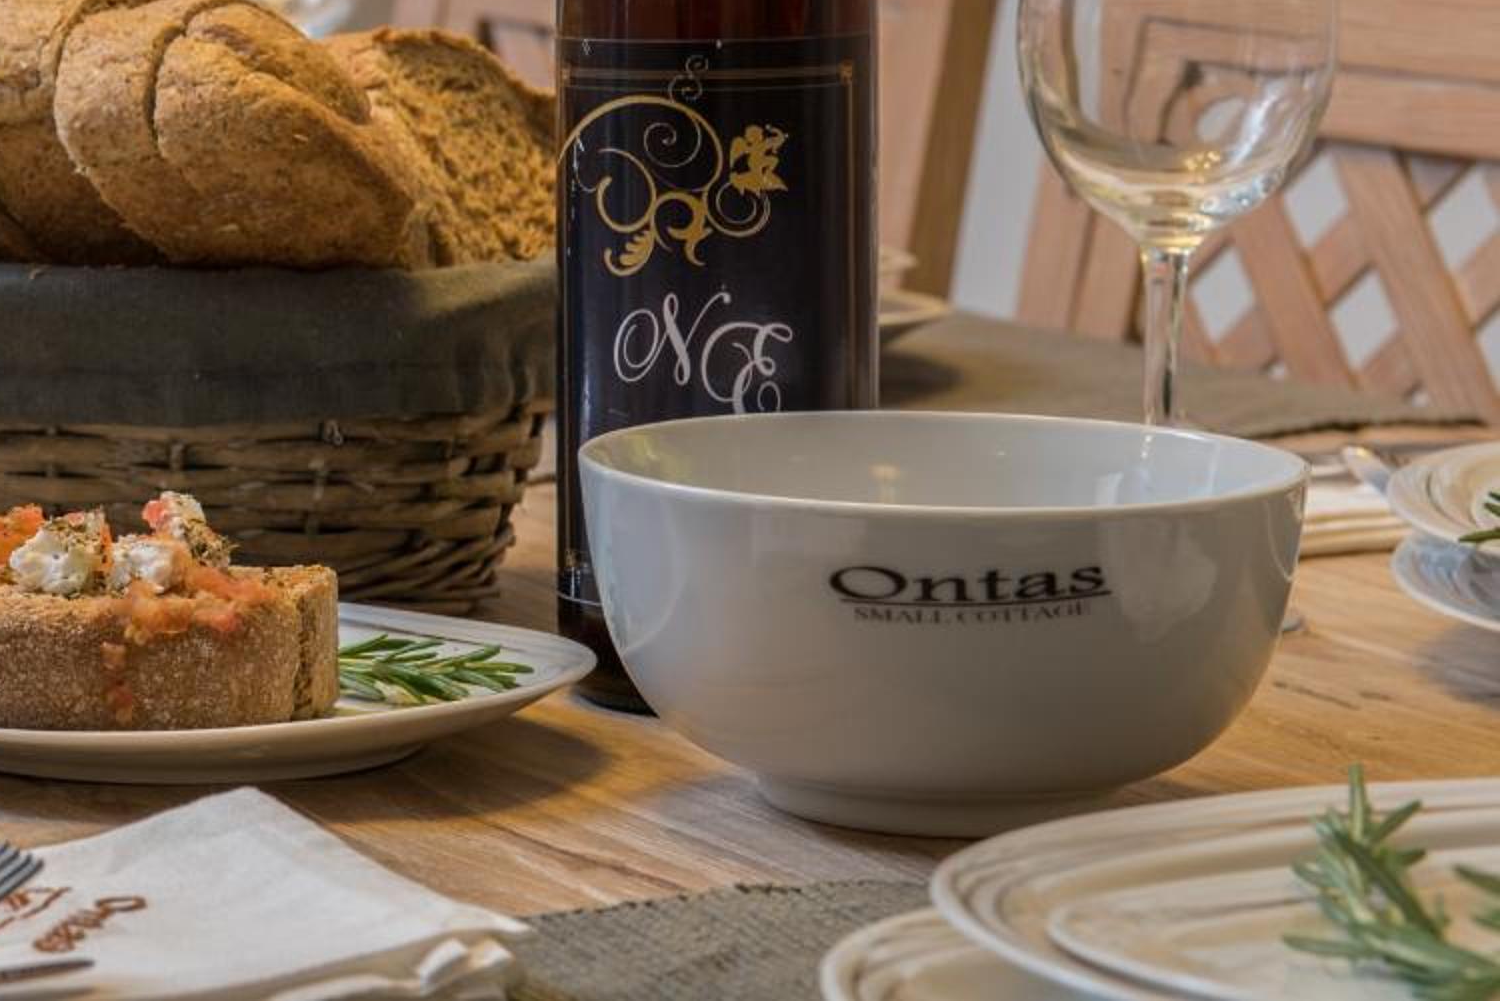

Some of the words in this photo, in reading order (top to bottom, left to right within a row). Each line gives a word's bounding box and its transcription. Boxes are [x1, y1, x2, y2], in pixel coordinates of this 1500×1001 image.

[828, 566, 1105, 601] Ontas
[854, 605, 943, 624] SMALL
[956, 601, 1091, 623] COTTAGE
